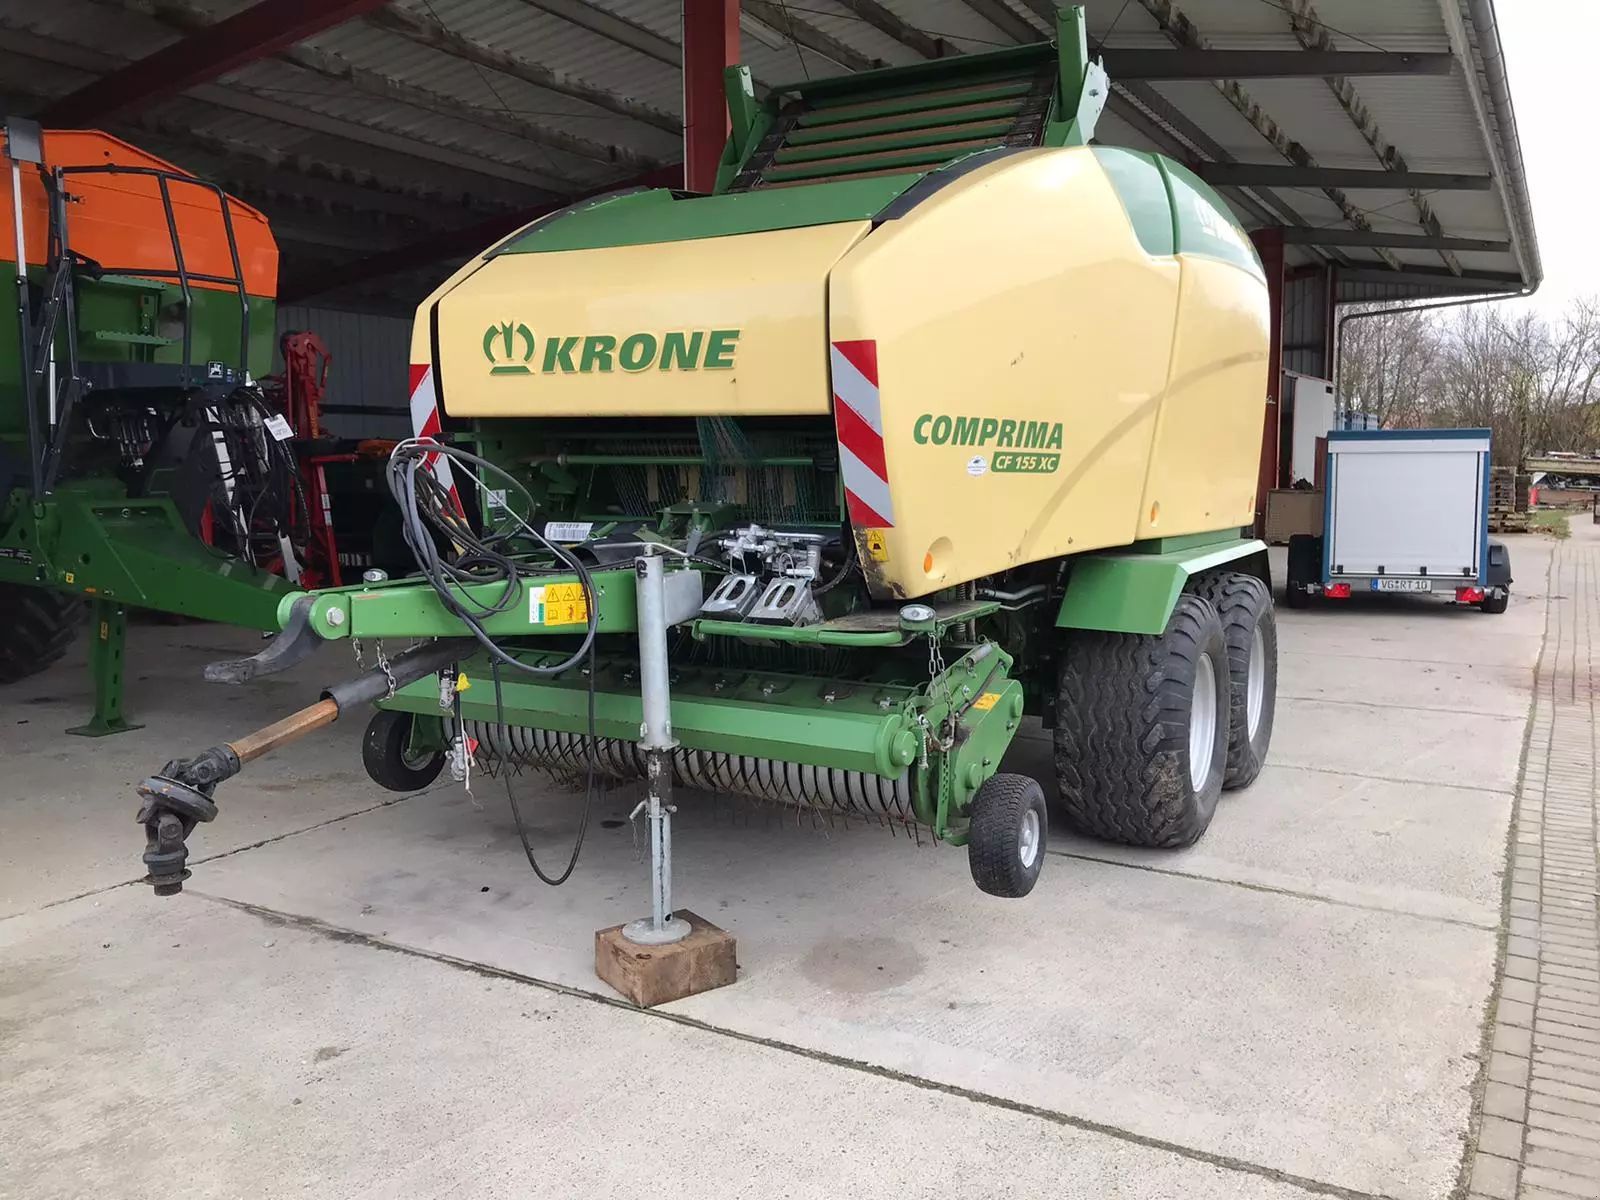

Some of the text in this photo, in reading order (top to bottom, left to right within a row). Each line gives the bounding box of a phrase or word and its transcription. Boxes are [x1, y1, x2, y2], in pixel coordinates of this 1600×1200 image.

[543, 330, 740, 373] KRONE
[913, 414, 1063, 450] COMPRIMA
[996, 456, 1013, 470] CF
[1015, 456, 1037, 471] 155
[1038, 457, 1057, 471] XC
